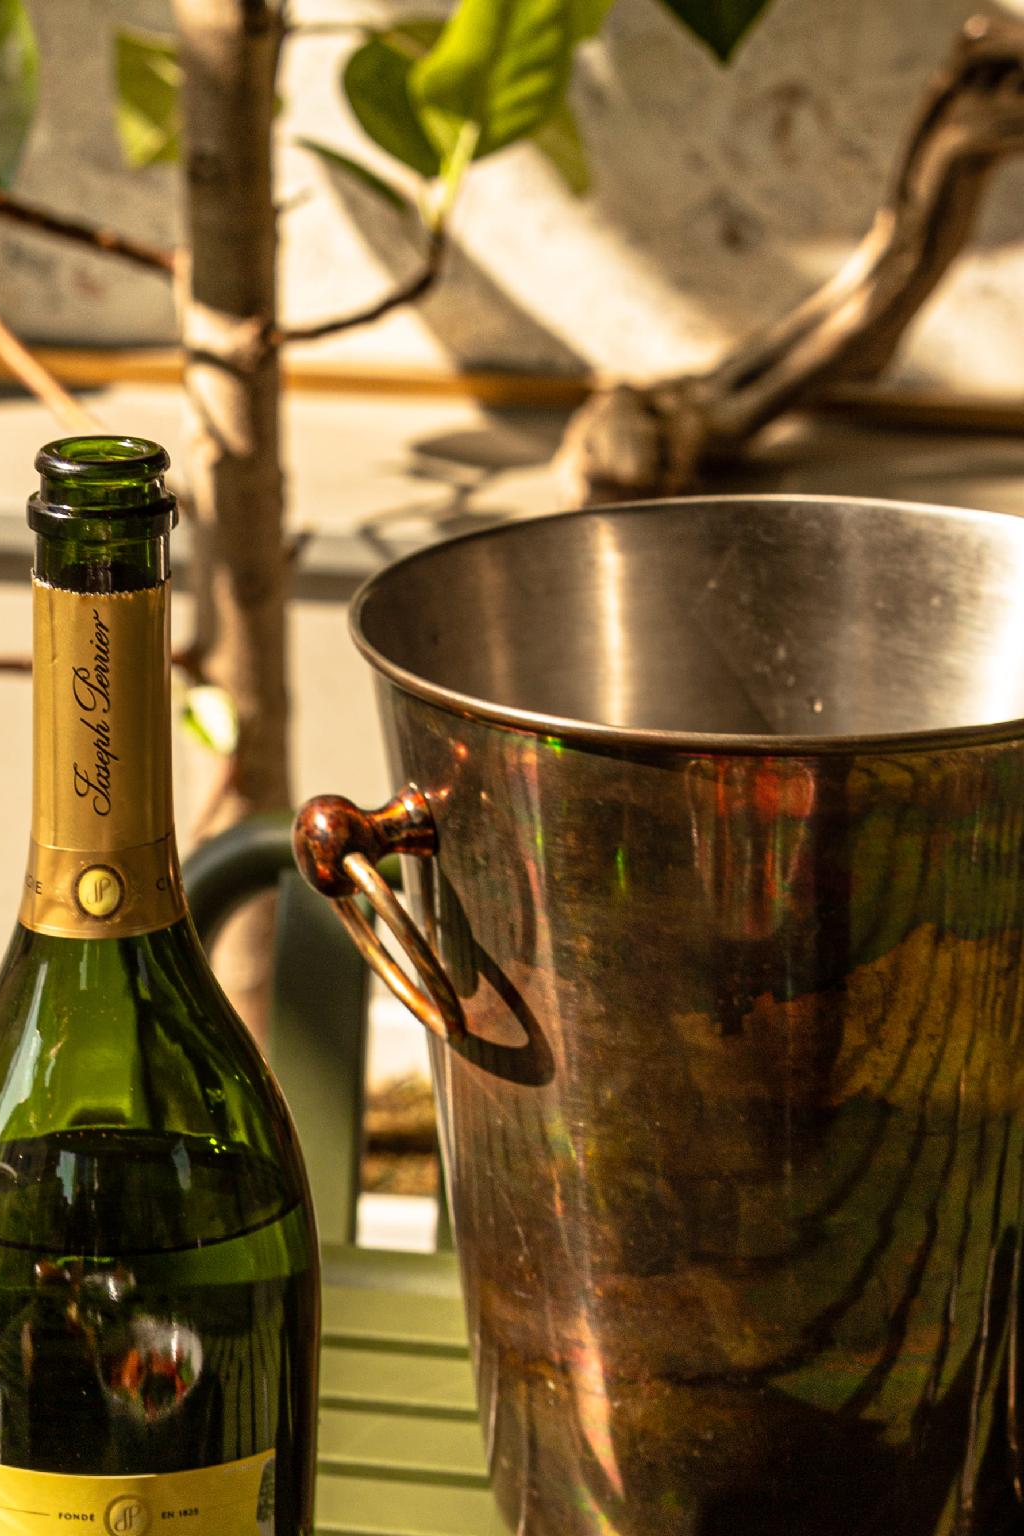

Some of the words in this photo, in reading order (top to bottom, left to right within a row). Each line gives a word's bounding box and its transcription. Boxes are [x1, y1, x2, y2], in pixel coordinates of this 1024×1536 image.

[72, 609, 110, 713] Perrier
[73, 718, 119, 816] Joseph
[161, 1510, 175, 1520] EN
